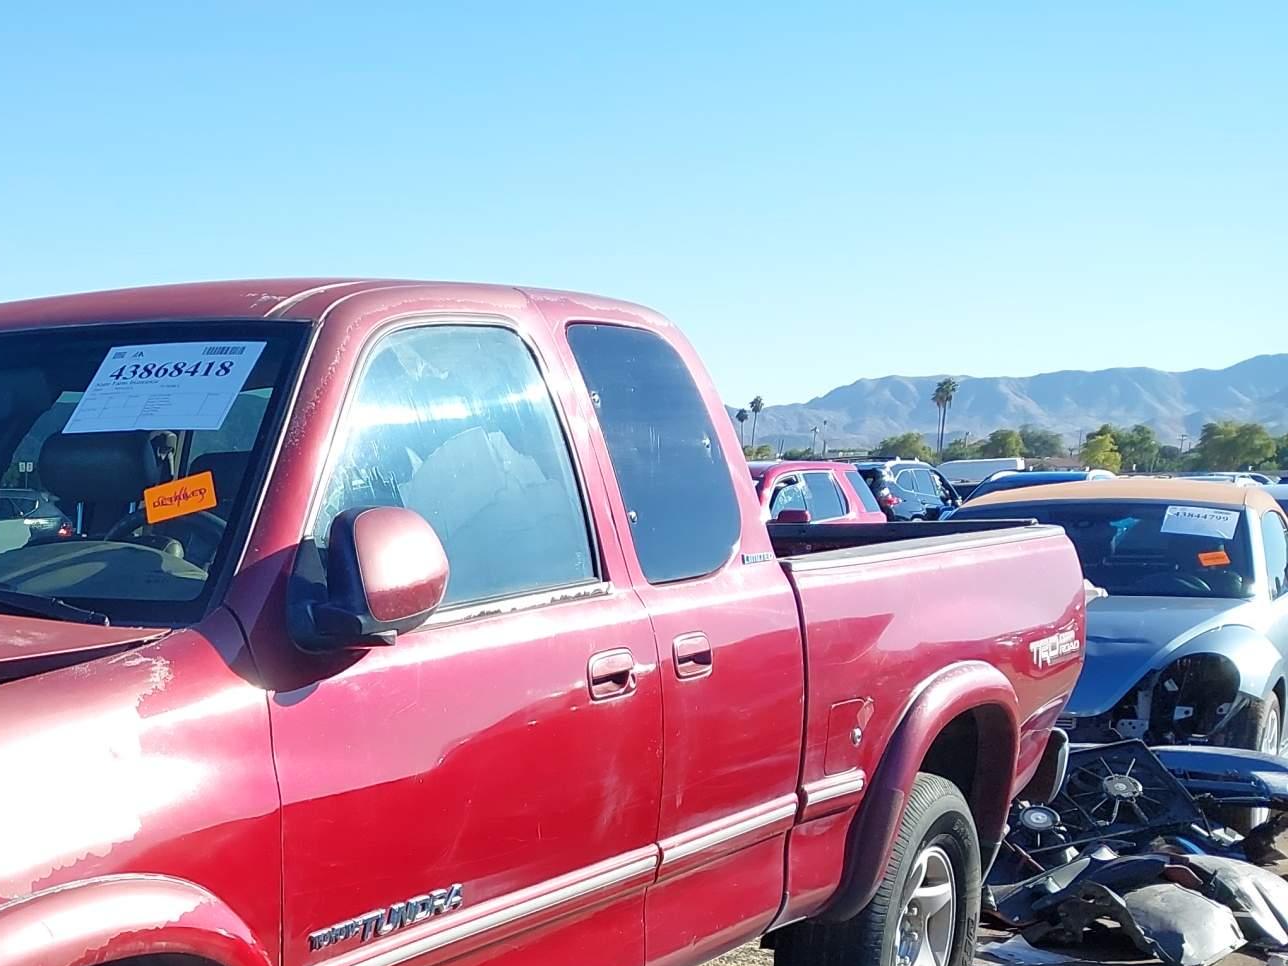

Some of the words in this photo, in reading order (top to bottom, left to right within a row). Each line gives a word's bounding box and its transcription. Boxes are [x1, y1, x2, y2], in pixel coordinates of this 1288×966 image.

[109, 360, 234, 381] 43868418
[1029, 633, 1059, 669] TRD
[1059, 640, 1080, 656] ROAD
[359, 883, 463, 943] TUNDRA
